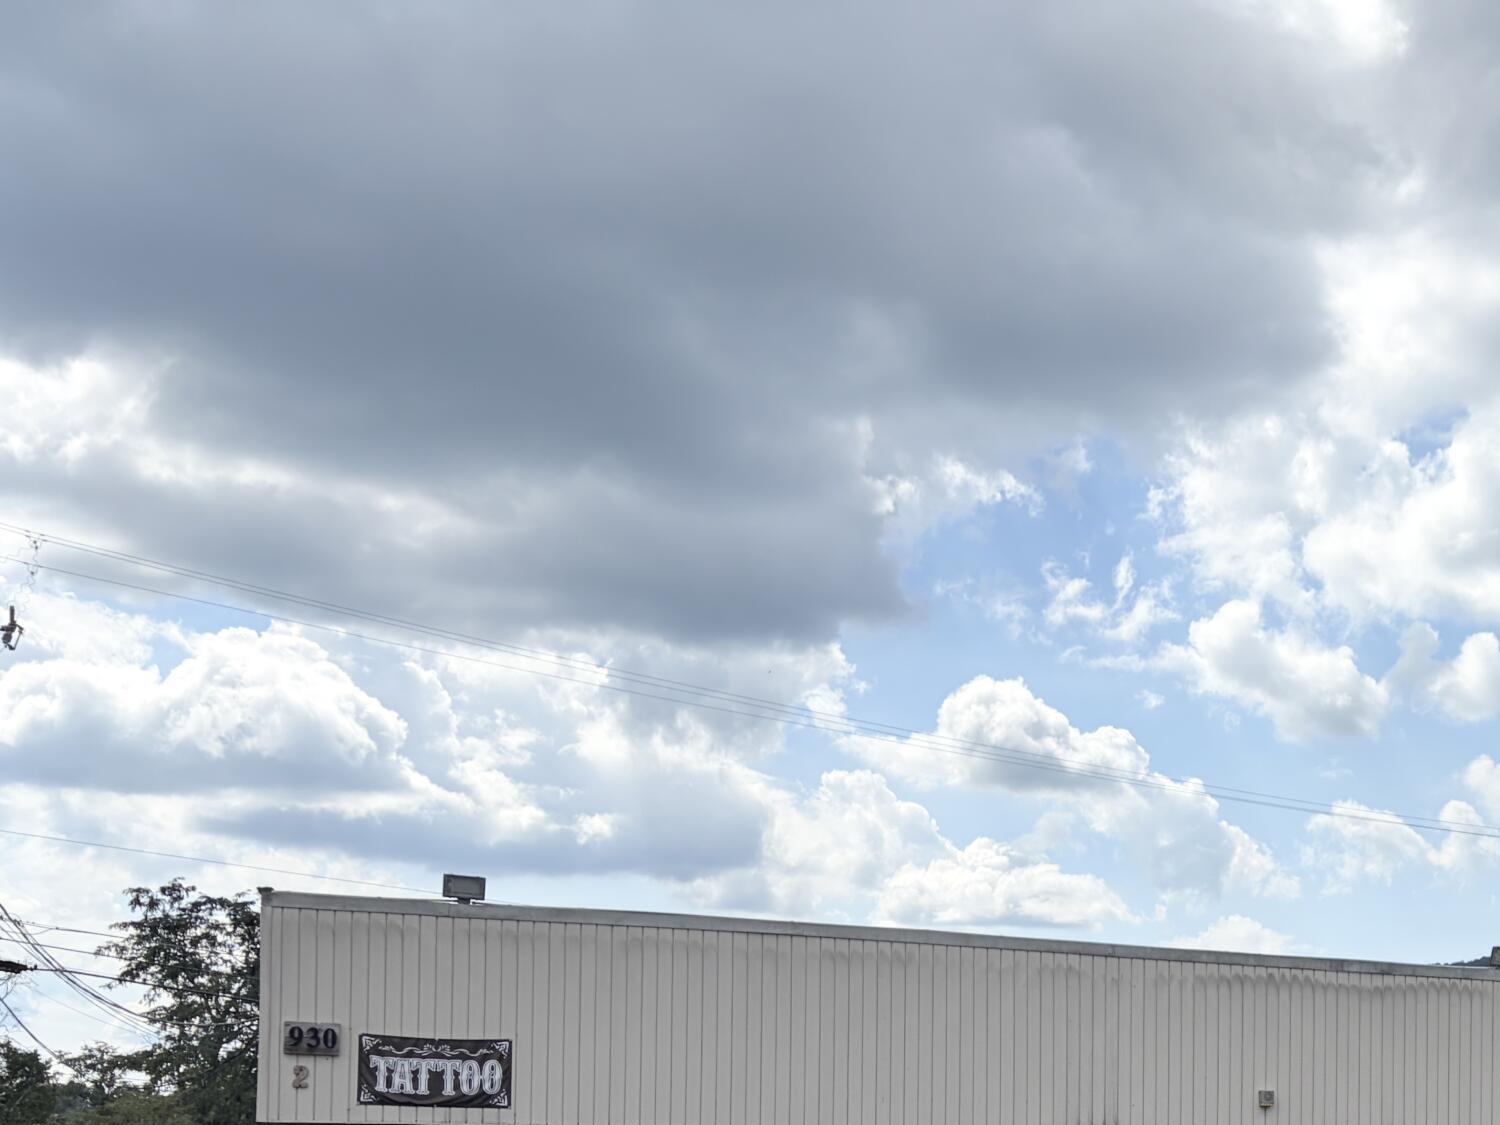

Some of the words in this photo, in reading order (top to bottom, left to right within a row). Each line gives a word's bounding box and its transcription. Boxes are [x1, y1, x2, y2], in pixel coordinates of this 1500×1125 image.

[288, 1026, 338, 1049] 930
[292, 1065, 309, 1089] 2
[369, 1055, 503, 1096] TATTOO
